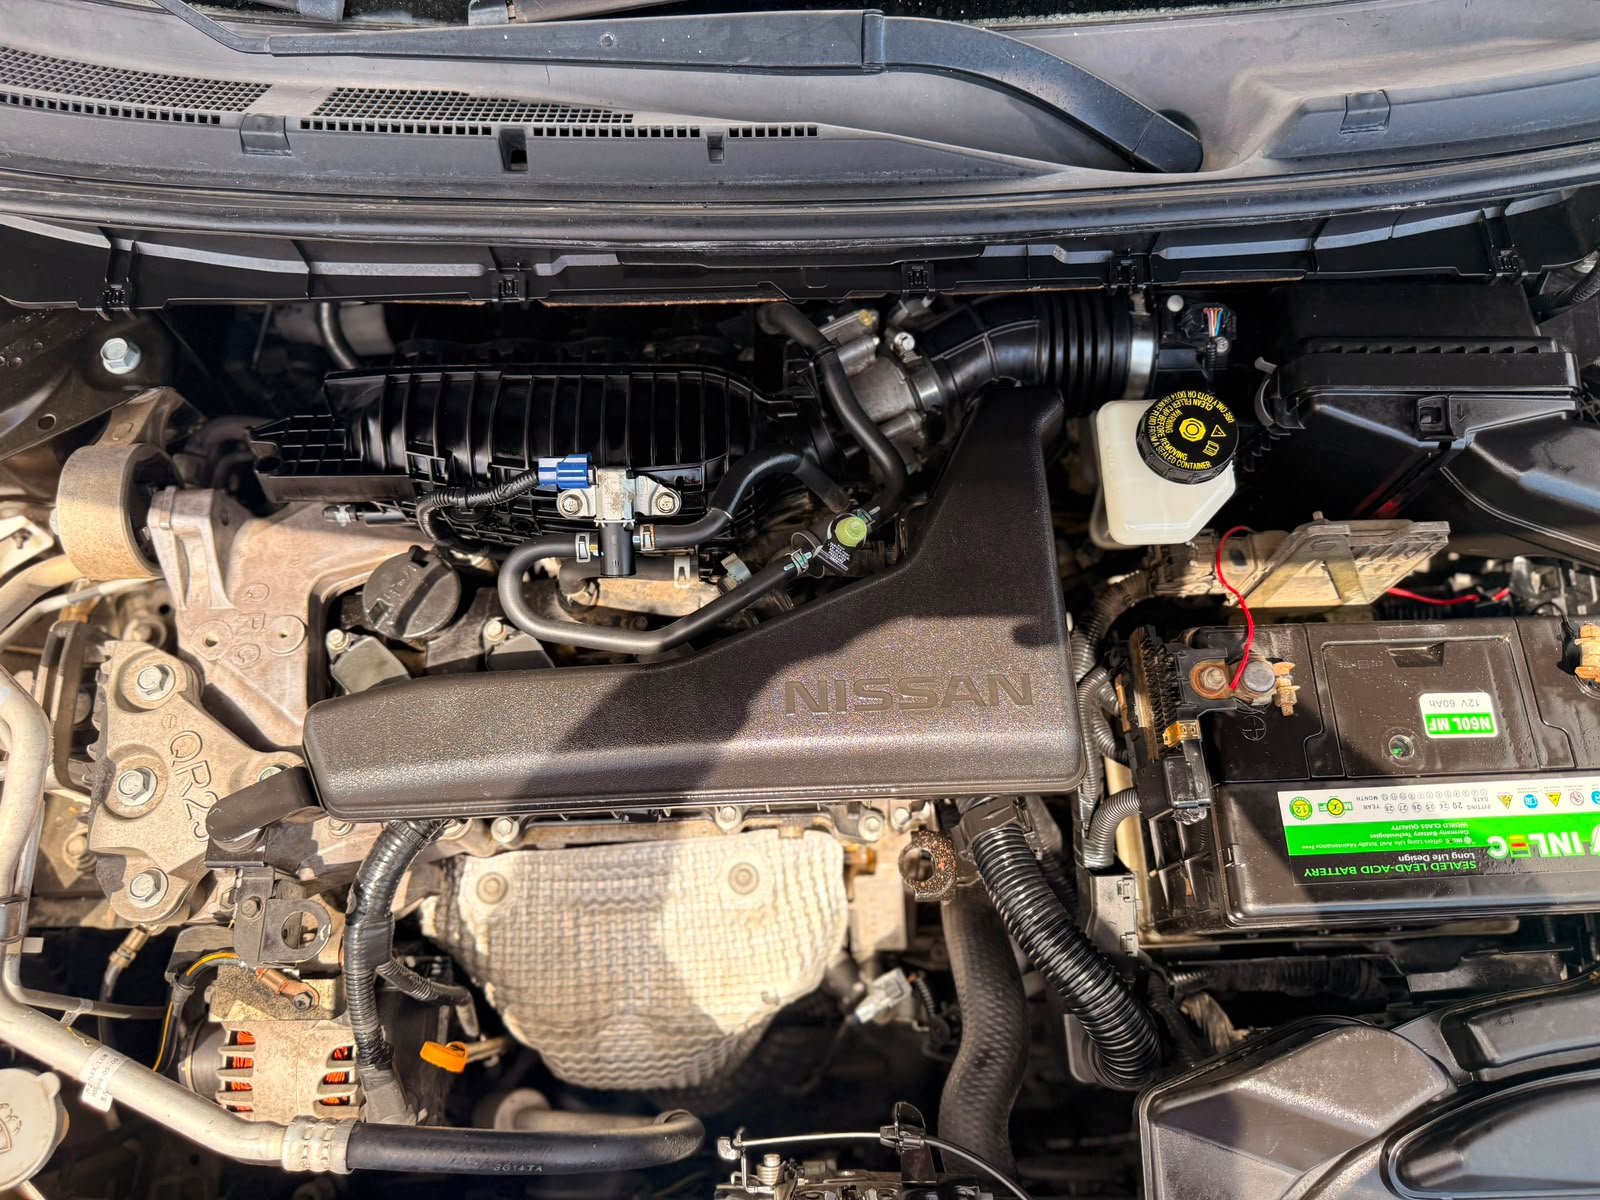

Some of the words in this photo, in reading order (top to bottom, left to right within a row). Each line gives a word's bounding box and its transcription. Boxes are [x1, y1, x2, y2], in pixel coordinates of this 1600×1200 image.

[1171, 391, 1187, 400] DOT4
[1187, 390, 1197, 399] OR
[1197, 391, 1214, 404] DOT3
[1154, 396, 1172, 412] BRAKE
[1171, 398, 1192, 409] FILLER
[1193, 399, 1214, 411] CLEAN
[1212, 401, 1228, 415] ONLY
[1148, 409, 1160, 426] FLUID
[1161, 406, 1174, 417] CAP
[1223, 411, 1236, 424] USE
[1156, 414, 1166, 438] BEFORE
[1165, 409, 1183, 434] WARNING
[1148, 426, 1158, 442] FROM
[1155, 445, 1177, 464] SEALED
[1160, 437, 1188, 461] REMOVING
[1176, 460, 1212, 470] CONTAINER
[784, 672, 1034, 716] NISSAN
[1428, 699, 1456, 708] 60Ah
[1461, 698, 1480, 708] 12V
[1428, 717, 1451, 732] MF
[1451, 716, 1492, 731] N60L
[1452, 801, 1463, 810] 20
[1304, 866, 1357, 877] BATTERY
[1360, 863, 1427, 874] LEAD-ACID
[1430, 861, 1477, 872] SEALED
